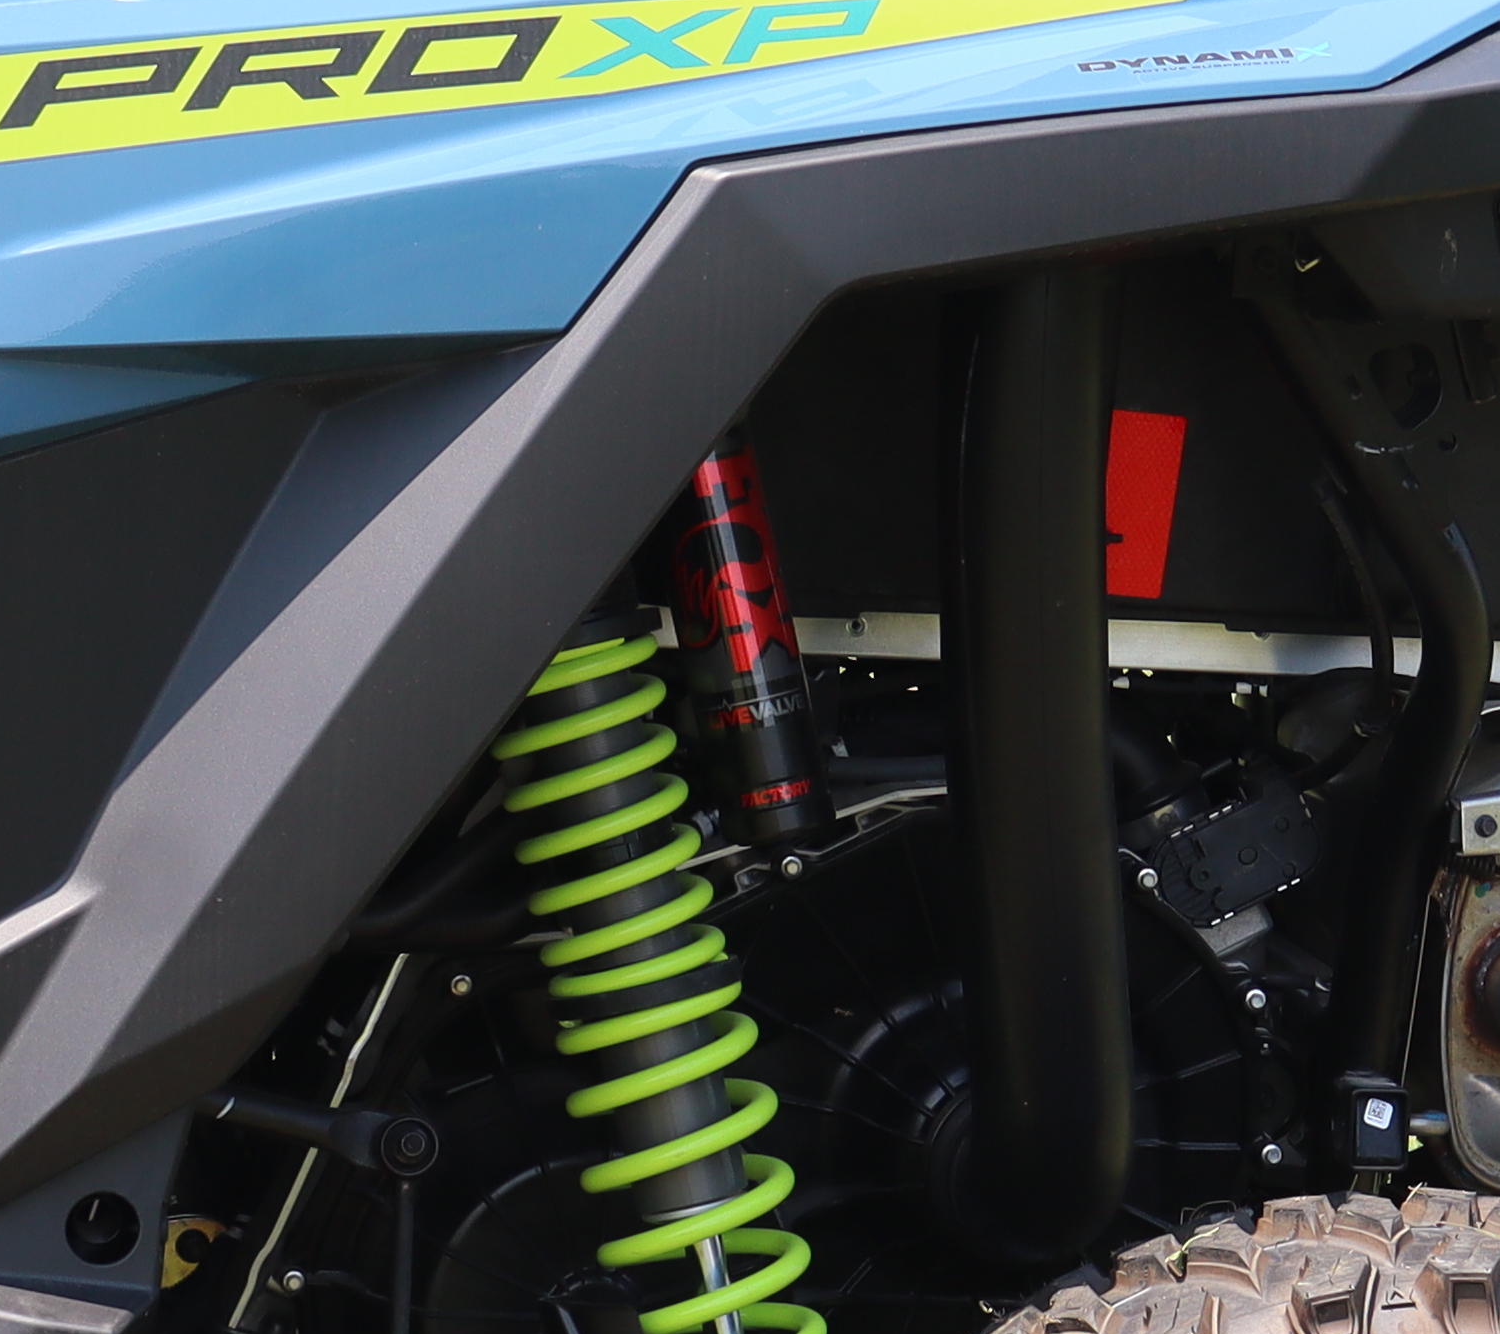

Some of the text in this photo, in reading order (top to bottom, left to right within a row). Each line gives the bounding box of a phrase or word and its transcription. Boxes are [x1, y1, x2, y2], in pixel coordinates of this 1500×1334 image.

[1077, 42, 1333, 73] DYNAMIX
[676, 441, 799, 673] FOX
[741, 778, 812, 808] FACTORY
